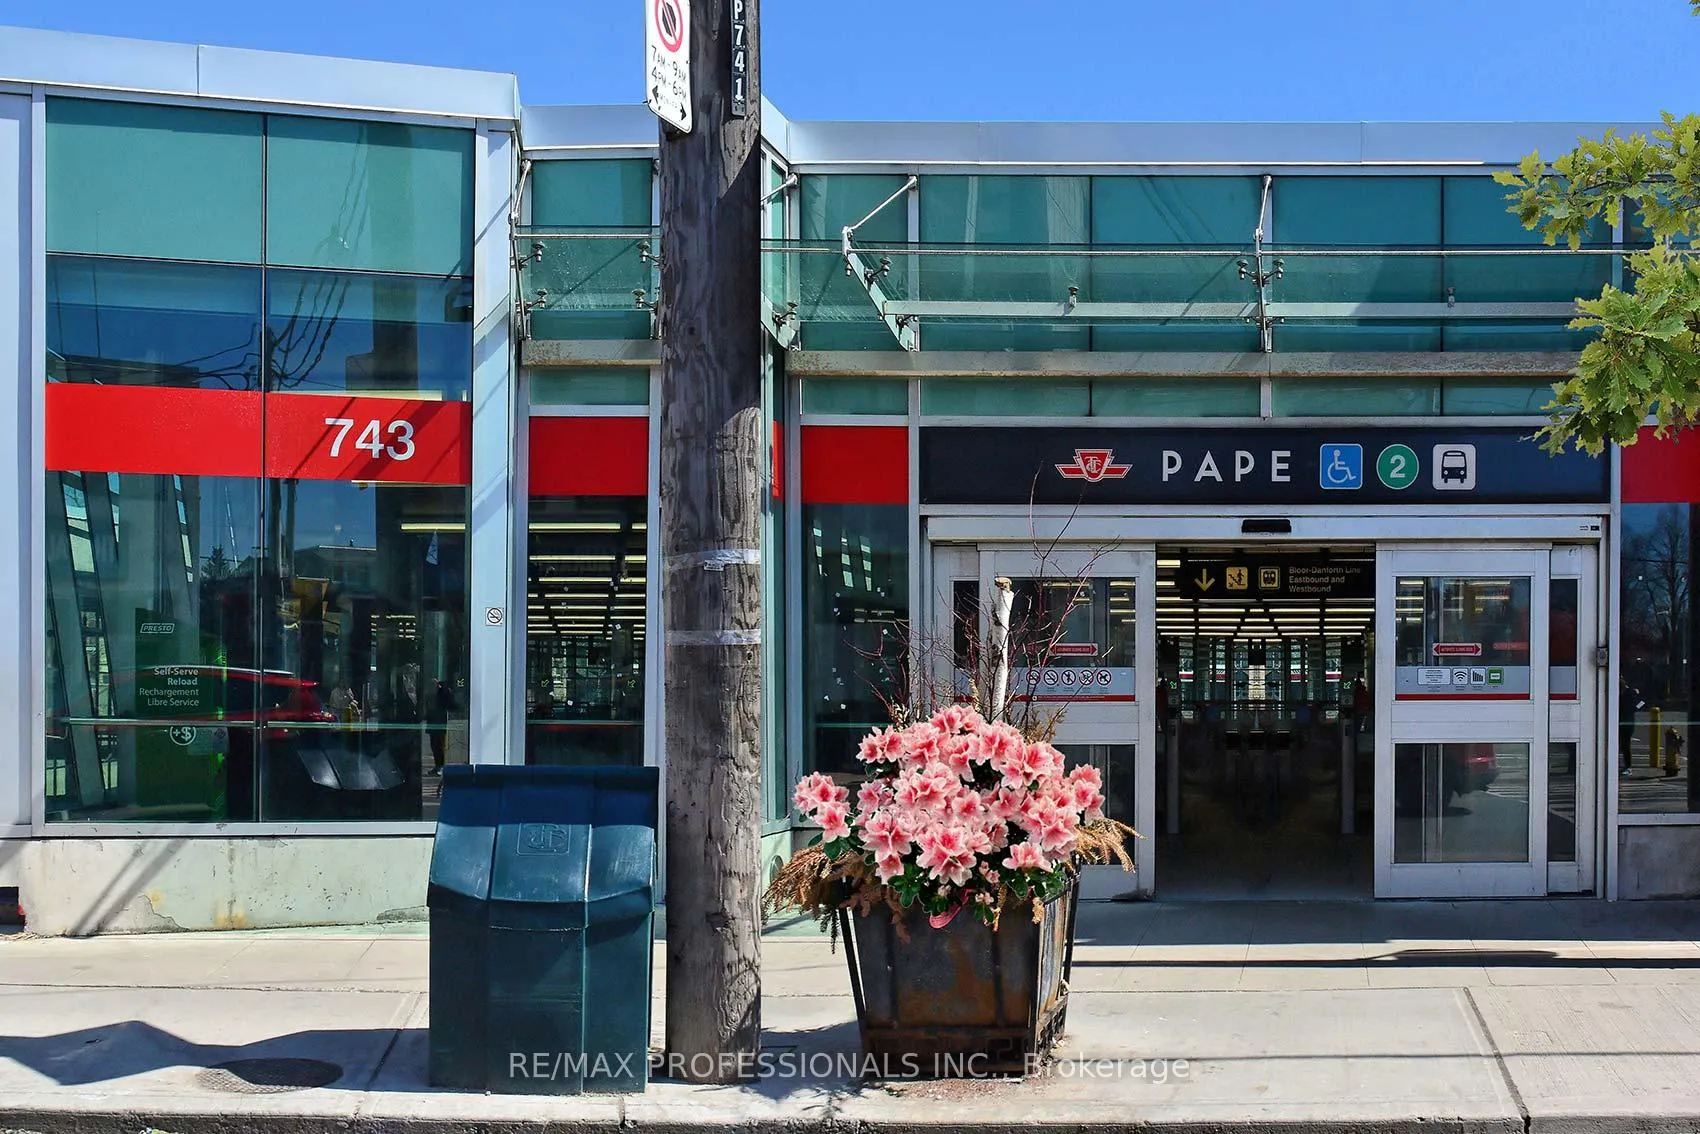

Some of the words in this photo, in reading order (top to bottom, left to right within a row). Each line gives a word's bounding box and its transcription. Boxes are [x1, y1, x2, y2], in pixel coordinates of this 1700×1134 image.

[325, 418, 415, 461] 743
[1162, 450, 1291, 482] PAPE
[1390, 454, 1406, 478] 2
[1288, 575, 1329, 583] Eastbound
[1331, 575, 1345, 583] and
[1288, 585, 1331, 593] Westbound
[143, 624, 172, 632] PRESTO
[154, 667, 199, 676] Self-Serve
[167, 677, 198, 686] Reload
[139, 687, 199, 698] Rechargement
[147, 698, 168, 706] Libre
[170, 698, 199, 706] Service
